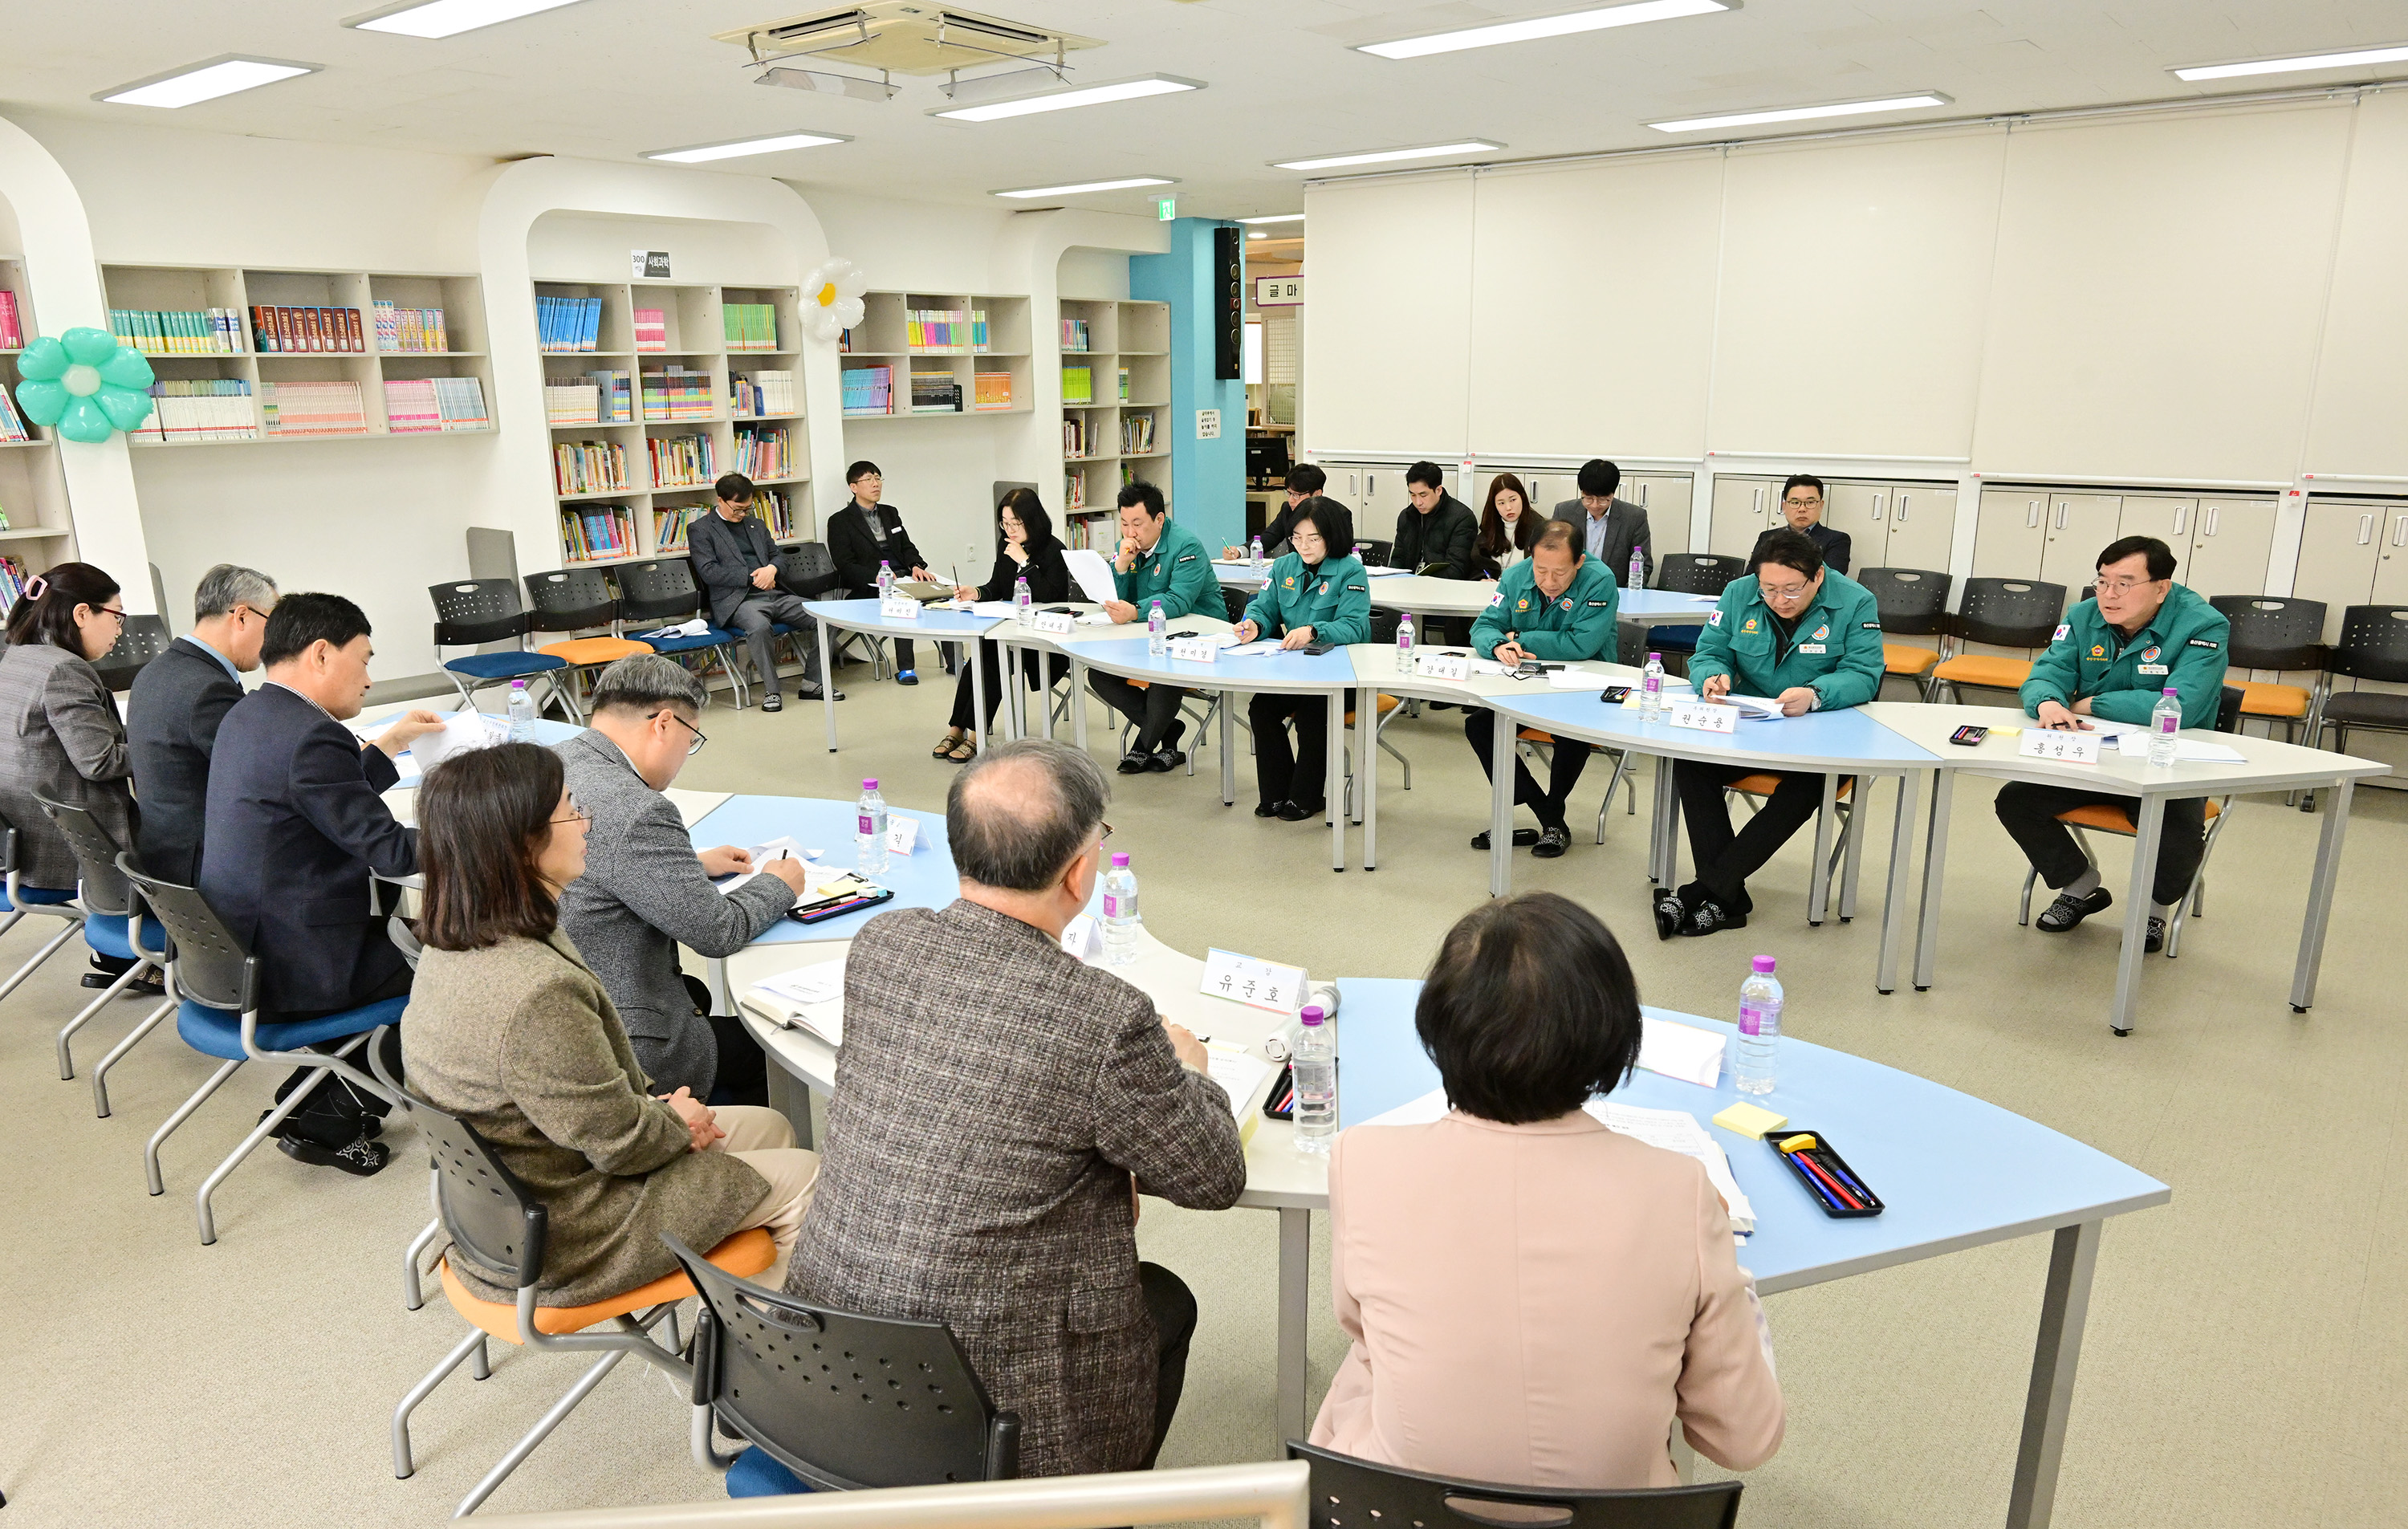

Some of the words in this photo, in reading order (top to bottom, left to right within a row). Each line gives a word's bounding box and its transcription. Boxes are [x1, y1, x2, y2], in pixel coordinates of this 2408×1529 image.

[633, 254, 645, 263] 300
[648, 255, 669, 268] 사회과학
[2033, 742, 2085, 758] 홍성우
[1219, 974, 1279, 1002] 유준호
